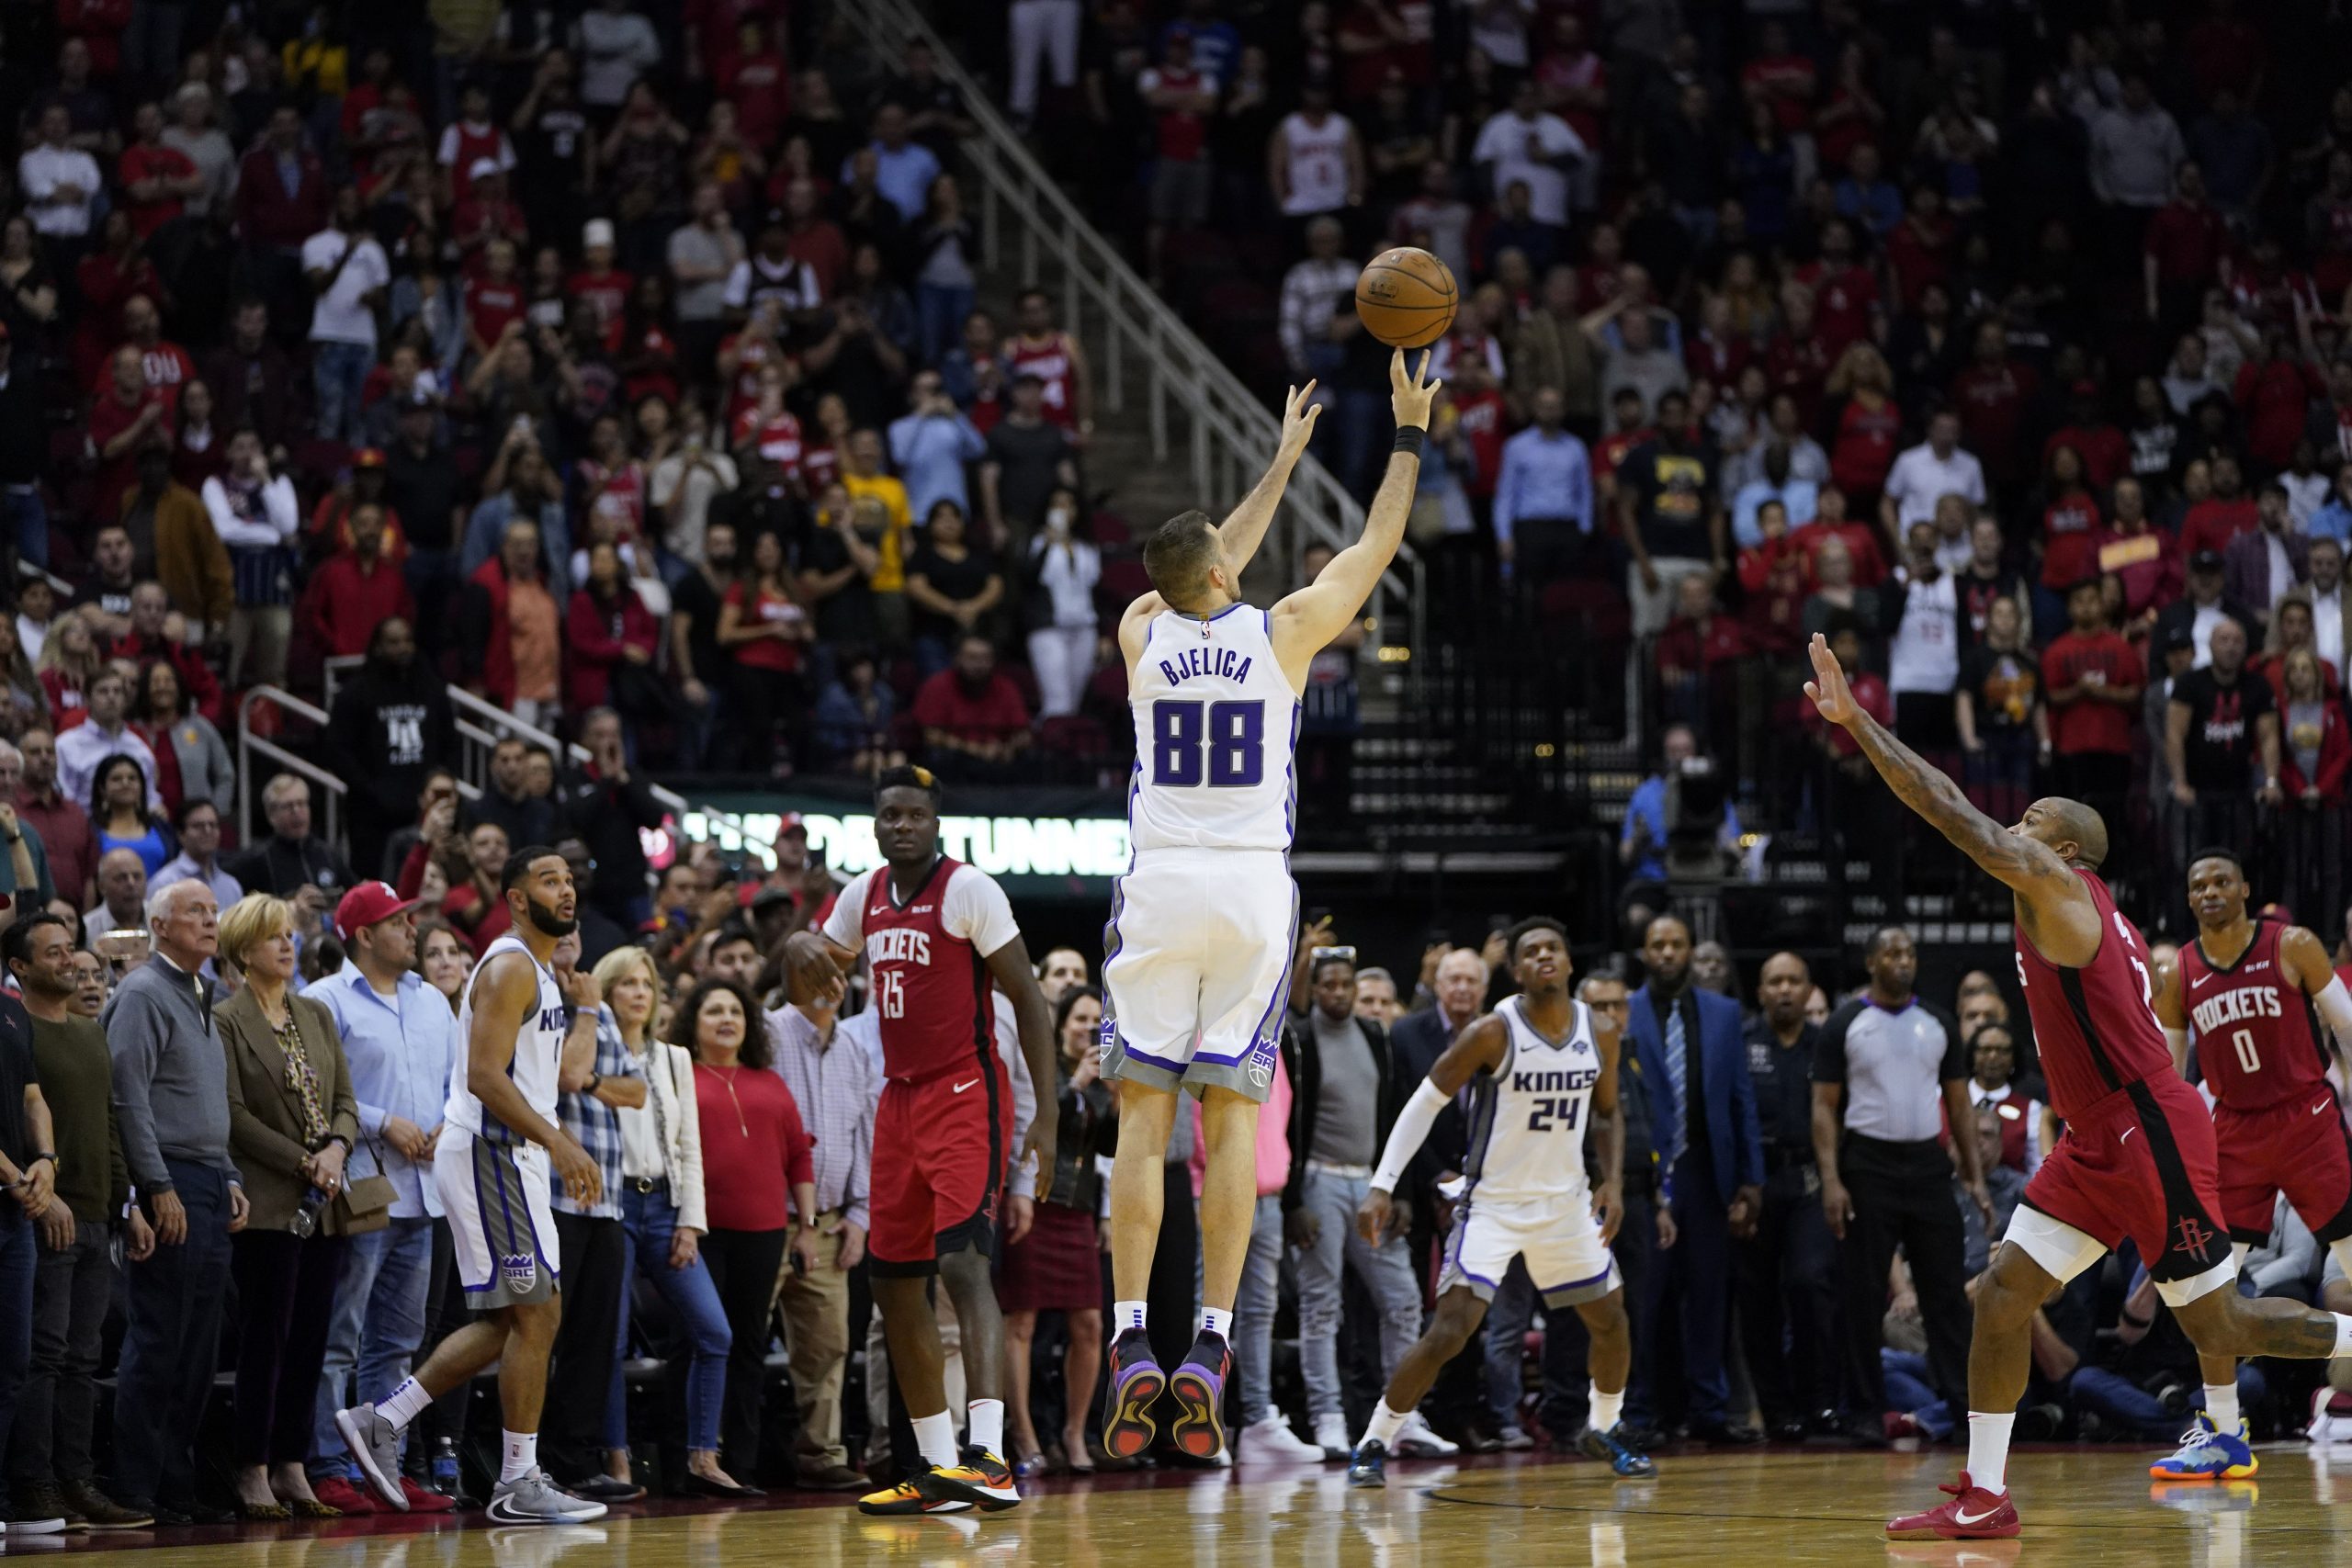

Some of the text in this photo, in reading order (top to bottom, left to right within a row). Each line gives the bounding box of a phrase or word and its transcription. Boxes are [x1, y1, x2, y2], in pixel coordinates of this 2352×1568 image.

[1159, 647, 1252, 687] BJELICA
[1152, 699, 1265, 787] 88
[866, 928, 931, 966] ROCKETS
[882, 970, 905, 1019] 15
[2192, 986, 2282, 1036] ROCKETS
[2232, 1029, 2261, 1074] 0
[1514, 1069, 1597, 1092] KINGS
[1528, 1098, 1580, 1132] 24
[504, 1269, 533, 1278] SAC
